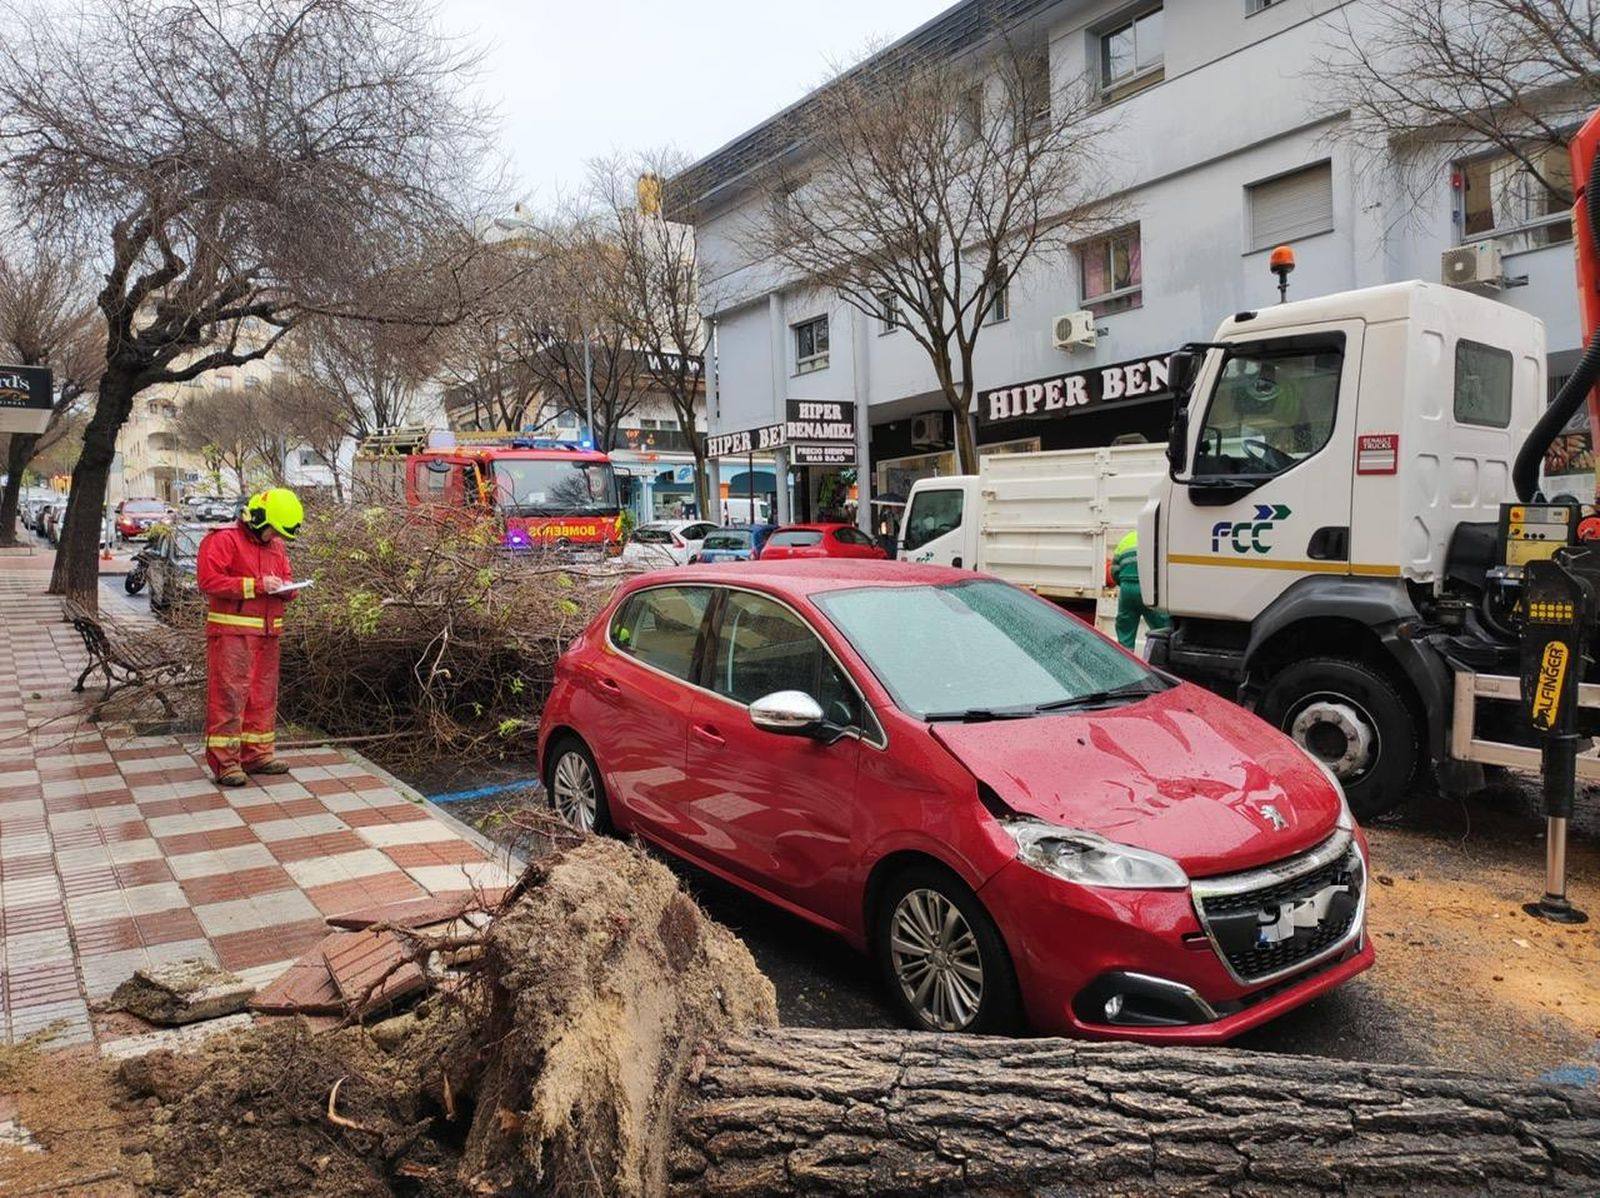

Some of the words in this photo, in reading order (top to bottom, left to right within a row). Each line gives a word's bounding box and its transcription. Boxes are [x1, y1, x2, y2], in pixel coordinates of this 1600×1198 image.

[988, 375, 1090, 421] HIPER
[799, 403, 842, 420] HIPER
[786, 422, 854, 439] BENAMIEL
[708, 431, 752, 457] HIPER
[797, 447, 823, 455] PRECIO
[1211, 521, 1274, 554] FCC
[1536, 647, 1564, 724] ALFINGER
